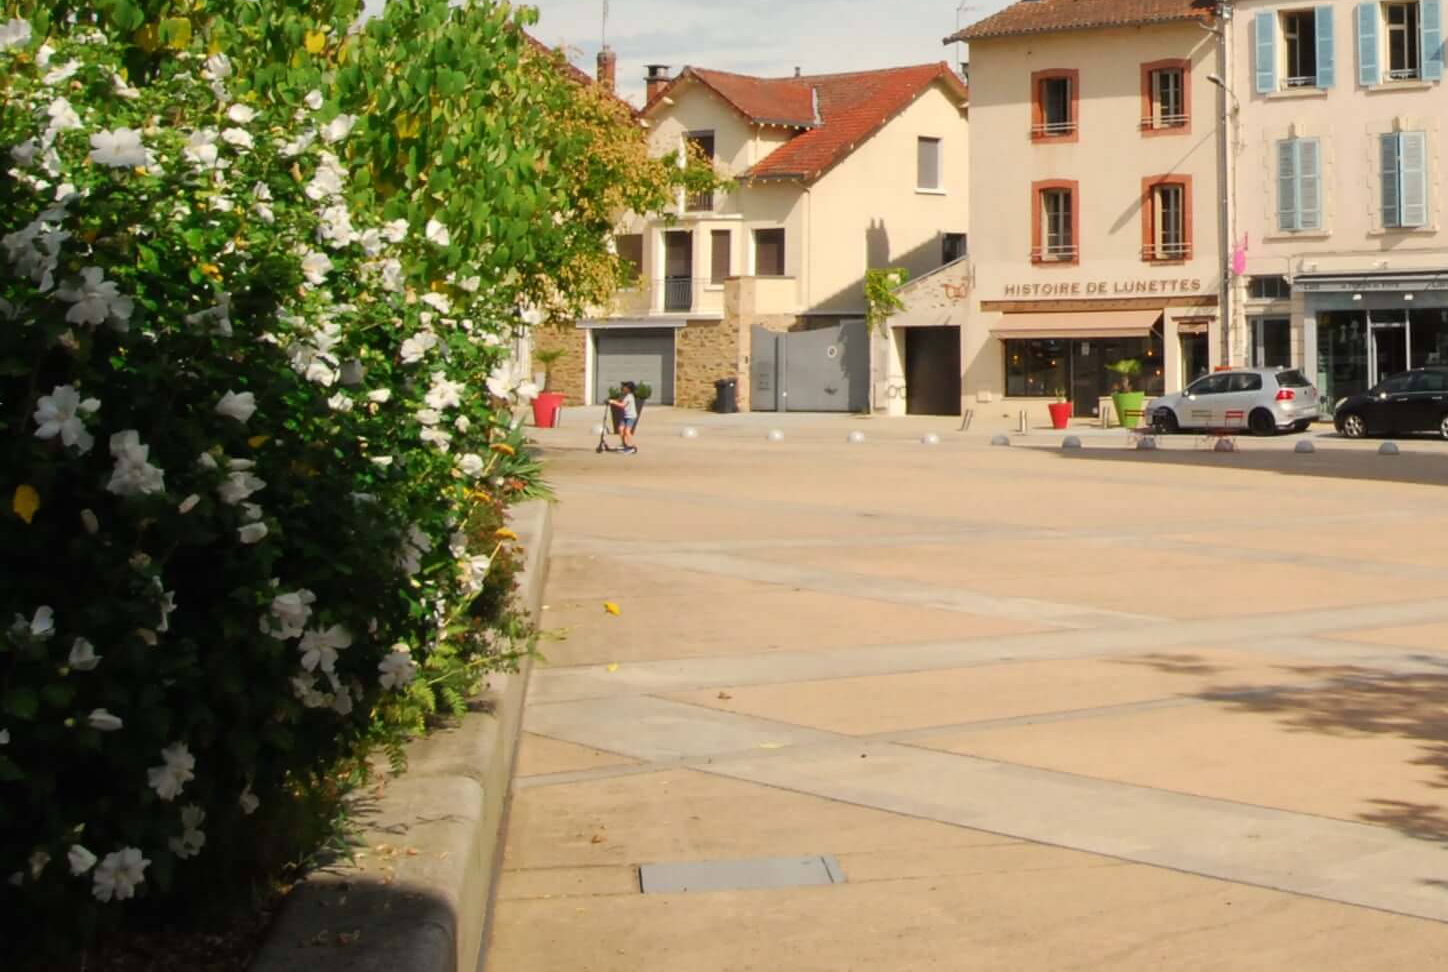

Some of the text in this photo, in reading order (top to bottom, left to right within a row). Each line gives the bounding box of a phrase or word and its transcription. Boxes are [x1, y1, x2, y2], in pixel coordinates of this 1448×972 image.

[1004, 279, 1201, 296] HISTOIRE DE LUNETTES
